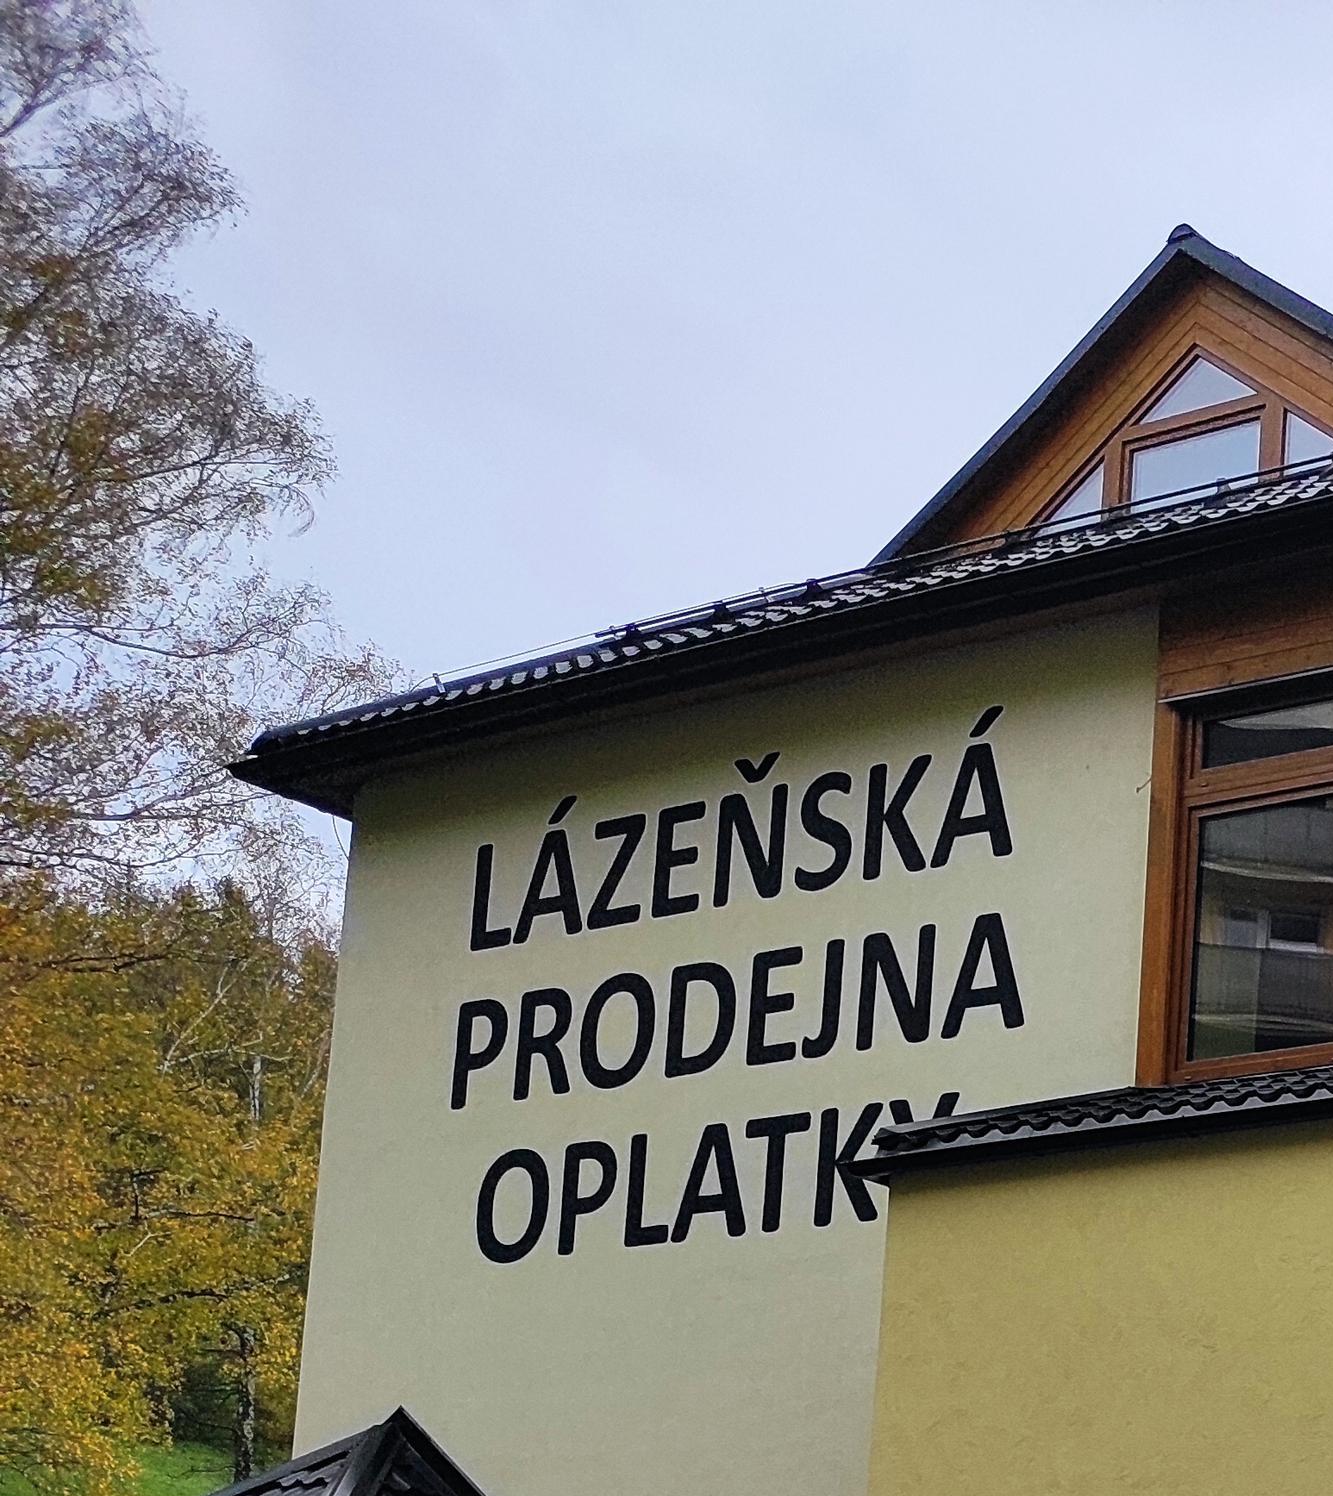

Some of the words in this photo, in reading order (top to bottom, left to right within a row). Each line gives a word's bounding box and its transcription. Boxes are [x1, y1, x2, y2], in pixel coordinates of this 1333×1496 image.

[469, 704, 1013, 952] LÁZEŇSKÁ
[450, 911, 1025, 1110] PRODEJNA
[476, 1091, 960, 1265] OPLATK
